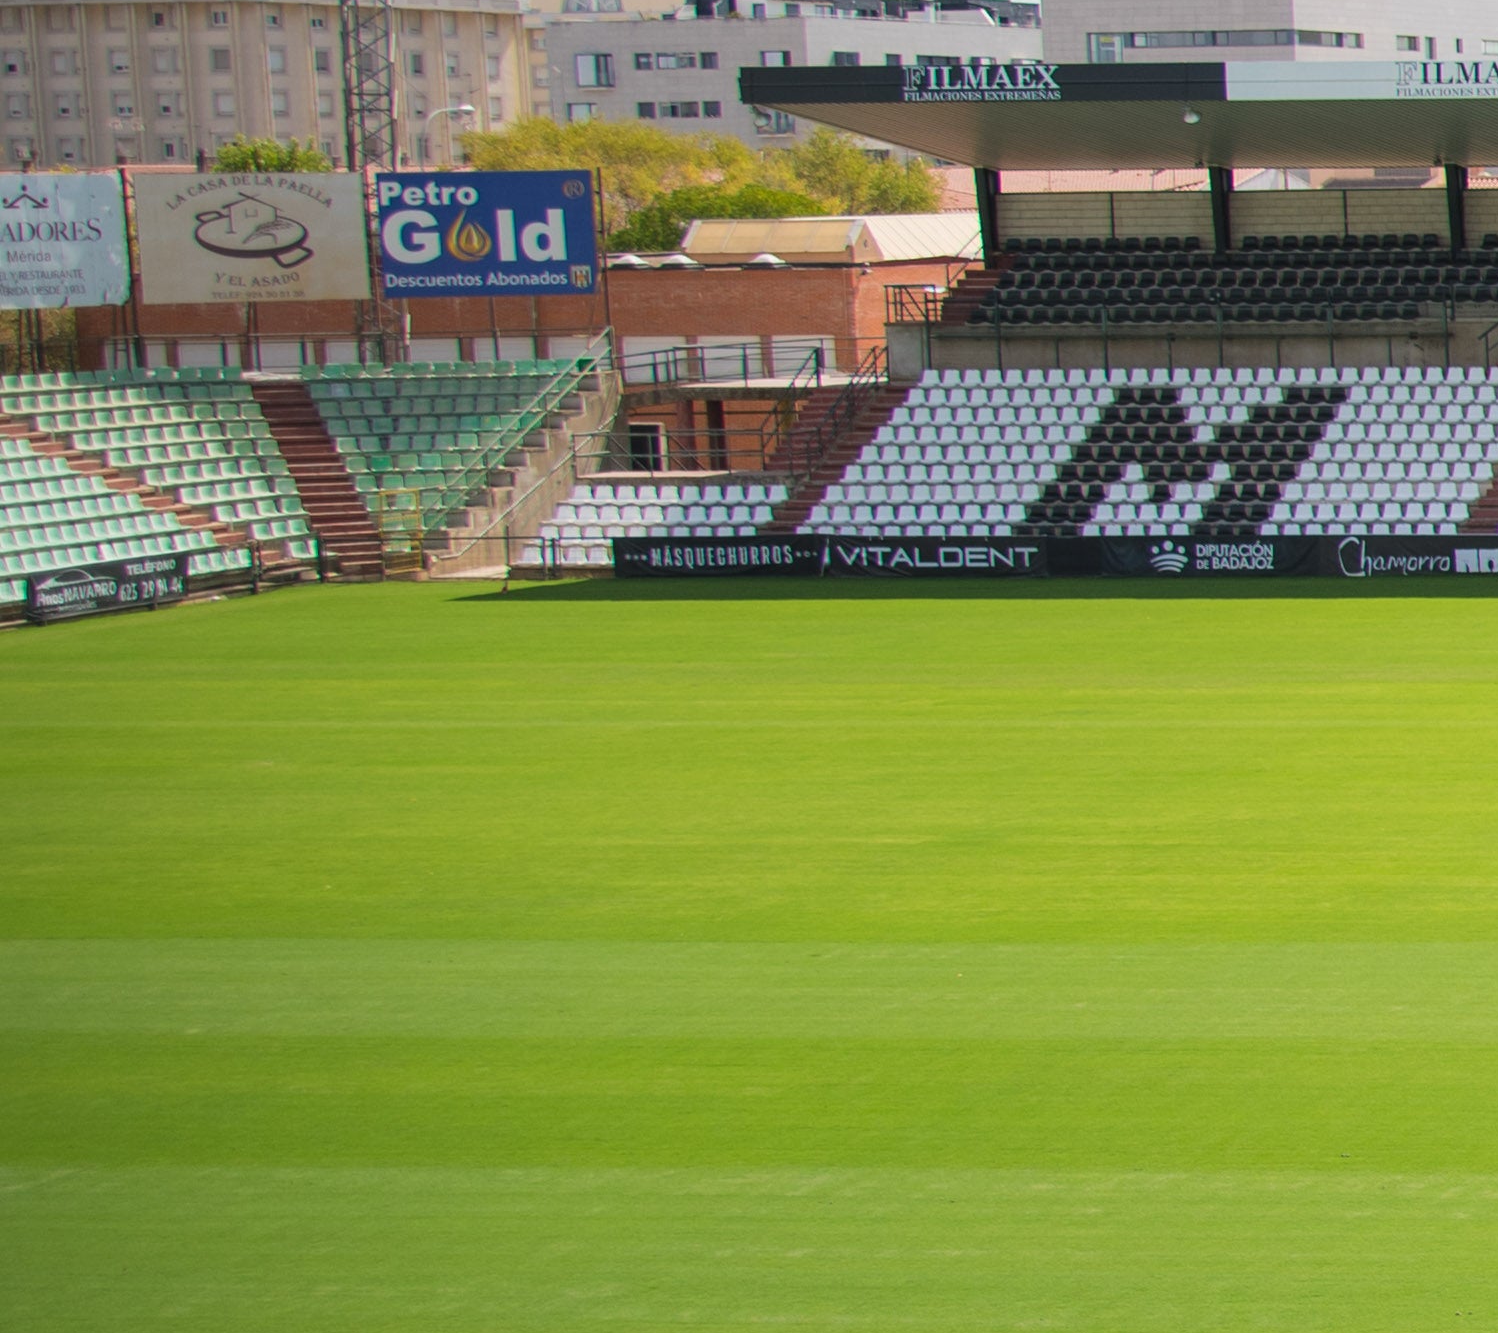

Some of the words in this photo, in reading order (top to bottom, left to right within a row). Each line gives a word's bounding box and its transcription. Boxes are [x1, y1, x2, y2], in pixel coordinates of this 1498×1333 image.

[902, 65, 1062, 90] FILMAEX
[904, 91, 982, 101] FILMACIONES
[984, 89, 1061, 101] EXTREMEÑAS
[1396, 87, 1473, 97] FILMACIONES
[166, 194, 183, 211] LA
[187, 175, 228, 197] CASA
[233, 174, 250, 186] DE
[255, 175, 273, 186] LA
[279, 177, 334, 209] PAELLA
[379, 181, 479, 207] Petro
[6, 250, 52, 264] Mérida
[18, 269, 85, 281] RESTAURANTE
[229, 272, 247, 287] EL
[251, 271, 301, 288] ASADO
[386, 273, 483, 288] Descuentos
[486, 271, 568, 286] Abonados
[651, 545, 793, 569] MÁSQUECHURROS
[837, 546, 1038, 568] VITALDENT
[1212, 557, 1274, 570] BADAJOZ
[1338, 536, 1450, 577] Chamorro
